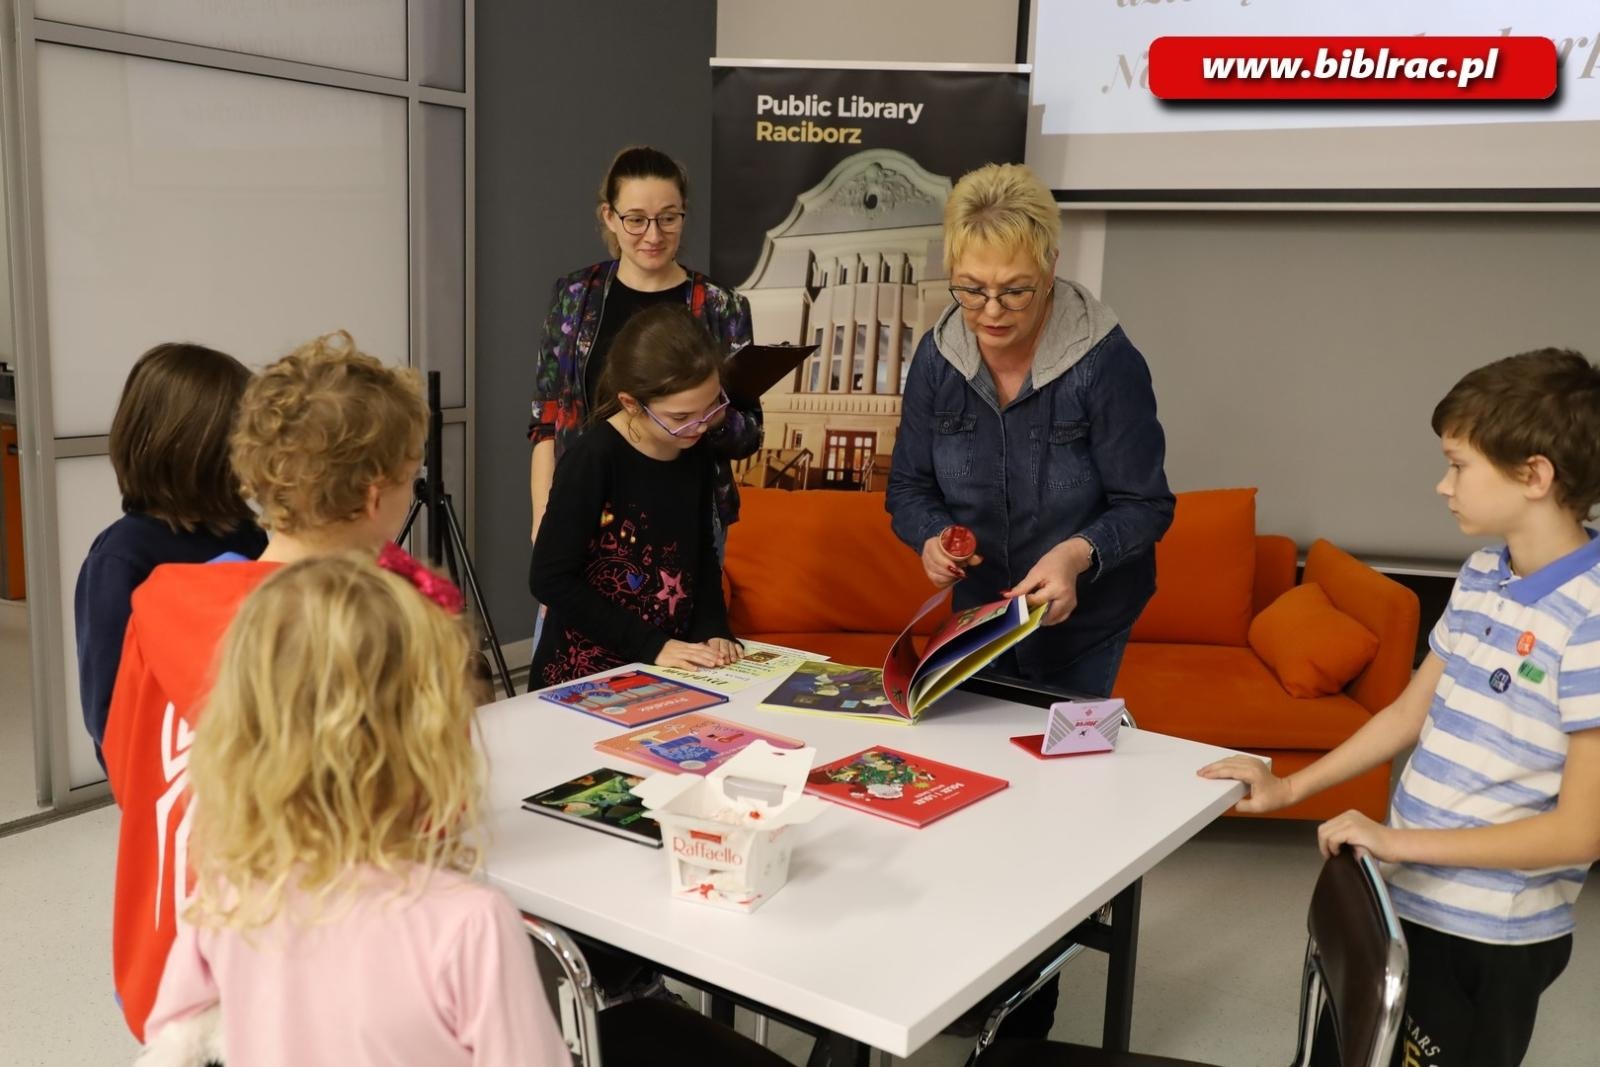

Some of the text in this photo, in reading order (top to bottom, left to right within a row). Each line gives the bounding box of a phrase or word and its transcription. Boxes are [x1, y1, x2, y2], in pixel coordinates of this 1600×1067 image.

[757, 94, 924, 125] Public Library
[756, 121, 862, 144] Raciborz
[673, 836, 743, 866] Raffaello
